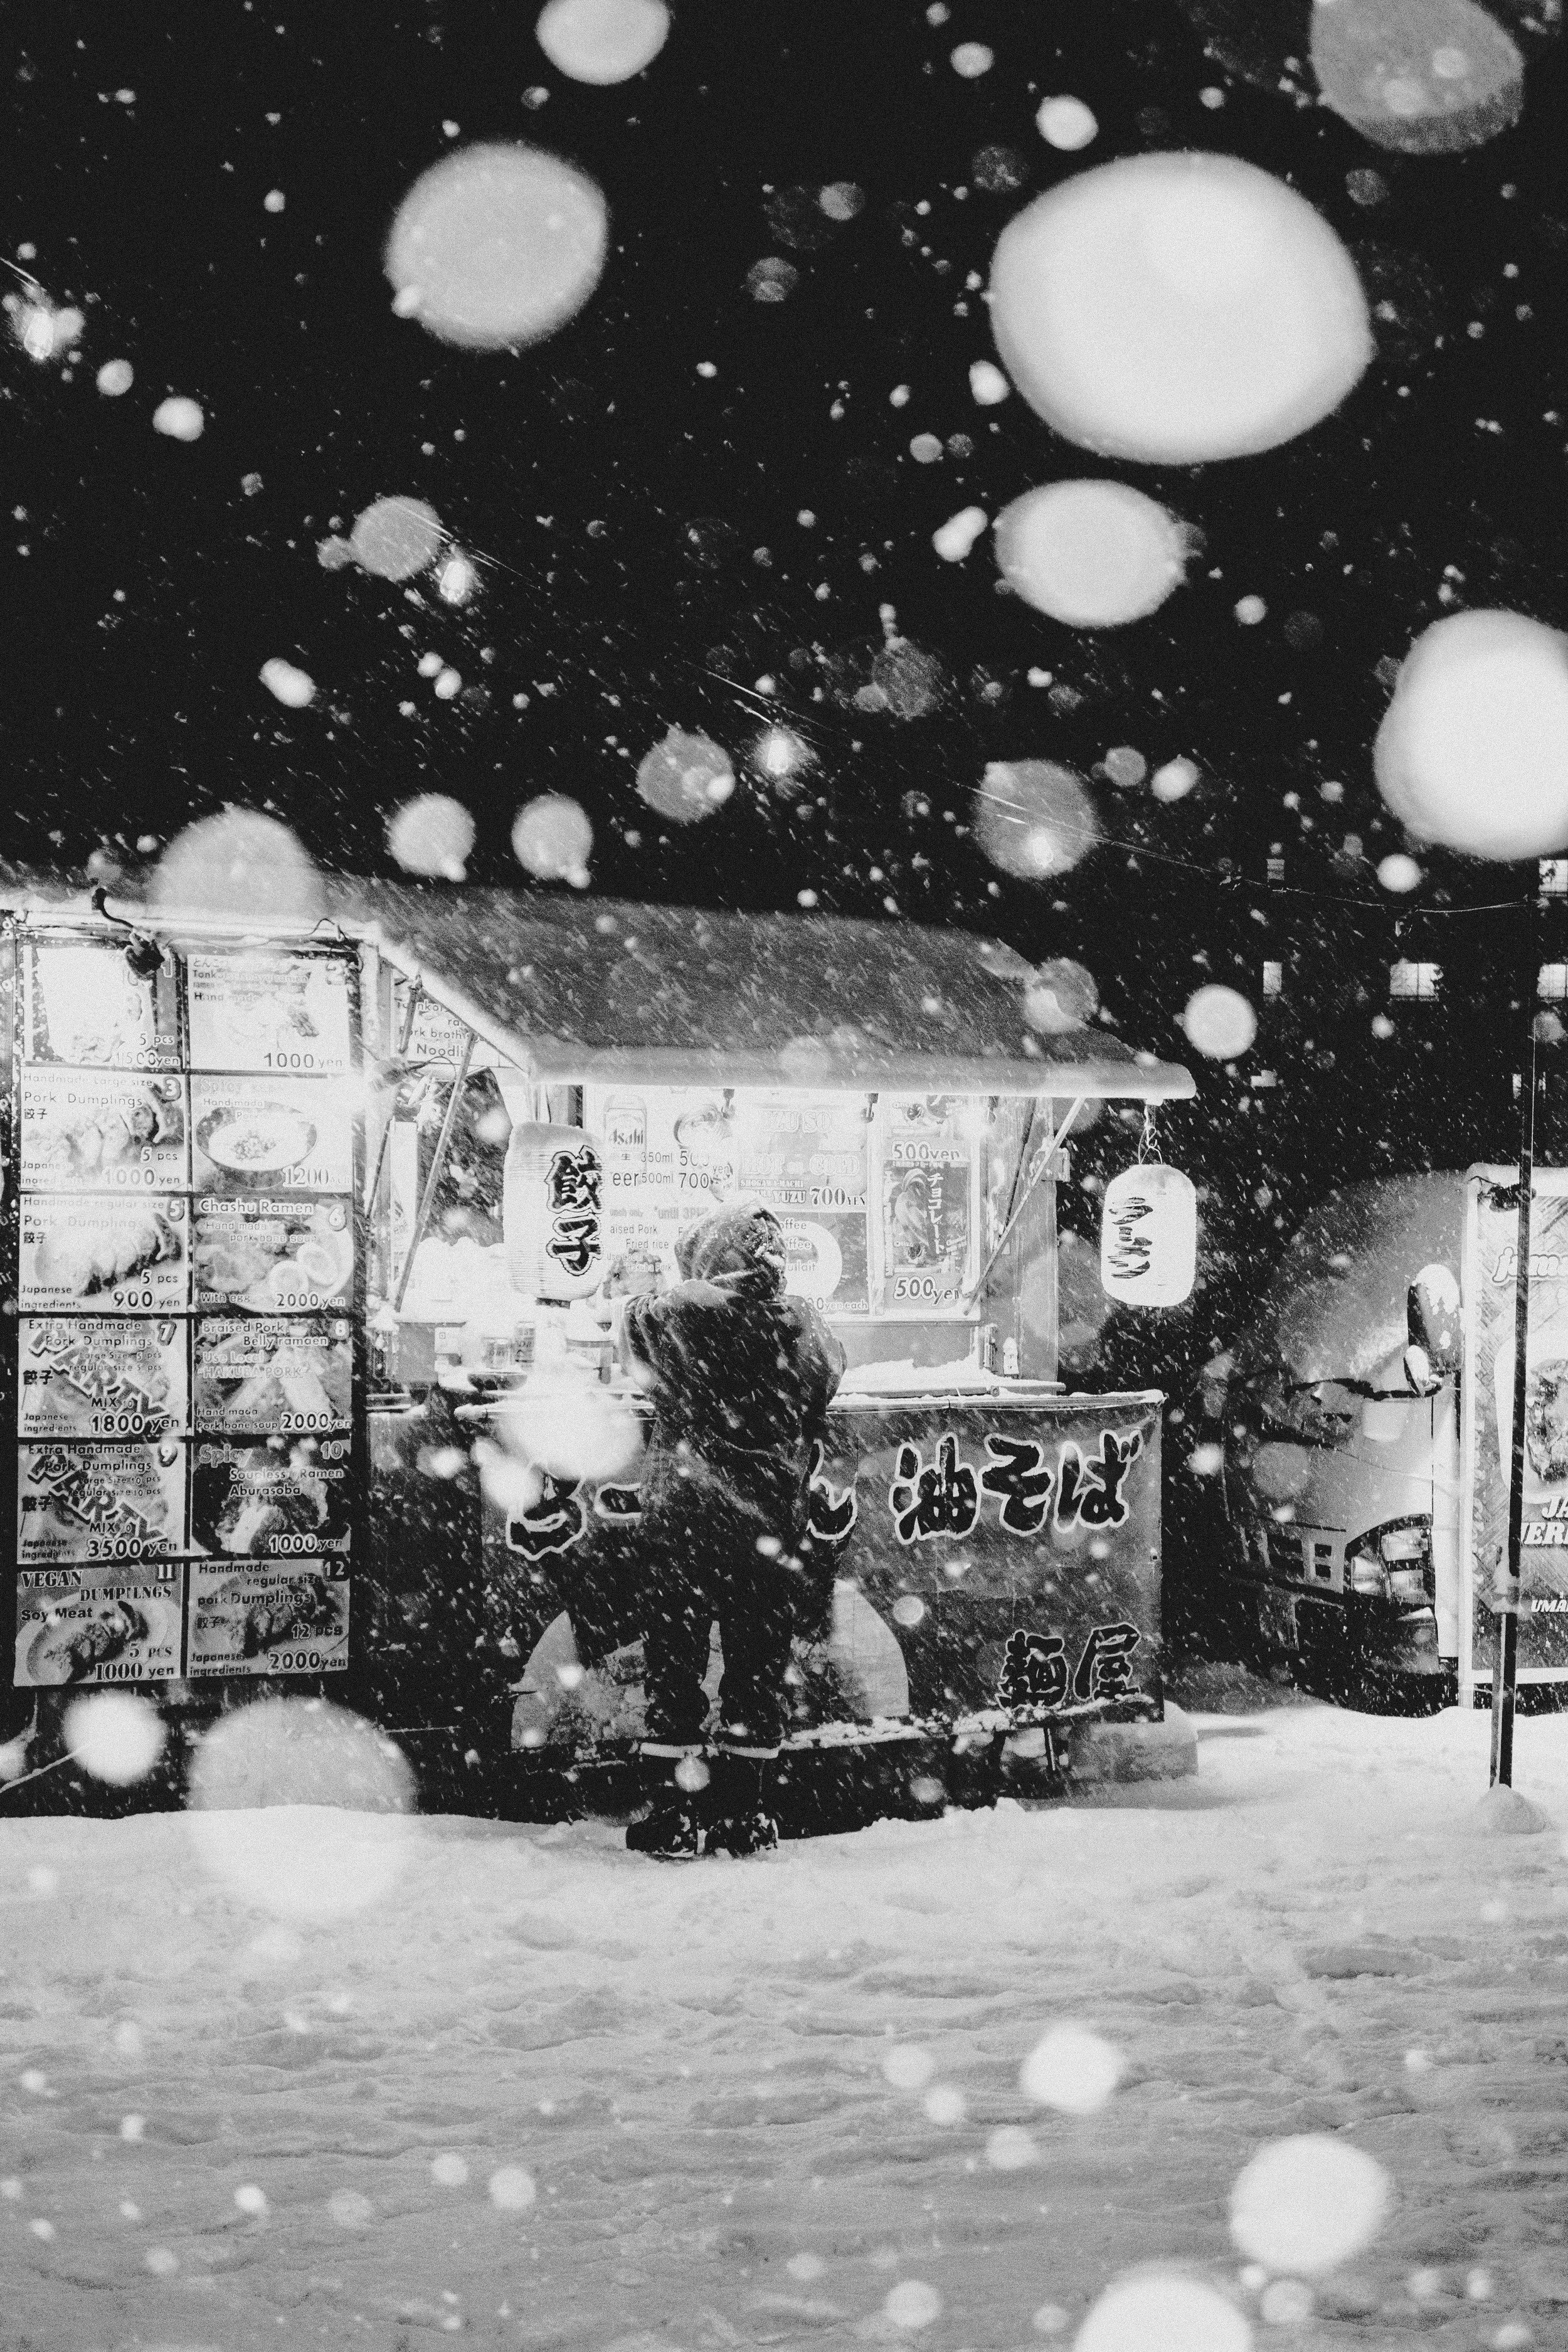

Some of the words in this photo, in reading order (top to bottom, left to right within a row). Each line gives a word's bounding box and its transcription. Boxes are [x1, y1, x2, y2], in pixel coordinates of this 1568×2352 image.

[139, 1033, 147, 1046] 5
[154, 1036, 174, 1046] pcs
[430, 1027, 462, 1039] broth
[263, 1052, 314, 1068] 1000
[318, 1057, 342, 1068] yen
[131, 1078, 153, 1086] size
[24, 1091, 56, 1103] Pork
[67, 1093, 143, 1108] Dumplings
[203, 1098, 231, 1106] Hand
[24, 1108, 48, 1120] 餃子
[608, 1128, 644, 1145] Asahi
[142, 1148, 151, 1162] 5
[157, 1152, 178, 1162] pcs
[640, 1152, 674, 1163] 350ml
[104, 1168, 156, 1185] 1000
[159, 1177, 181, 1186] yen
[612, 1172, 639, 1187] eer
[641, 1172, 674, 1184] 500ml
[678, 1172, 710, 1189] 700
[23, 1197, 90, 1207] Handmade
[94, 1199, 138, 1210] regular
[142, 1200, 165, 1209] size
[200, 1198, 257, 1213] Chashu
[260, 1199, 314, 1215] Ramen
[544, 1144, 603, 1277] 餃子
[927, 1172, 944, 1254] チョコレート
[23, 1214, 58, 1227] Pork
[67, 1216, 143, 1230] Dumplings
[205, 1222, 235, 1231] Hand
[610, 1224, 635, 1234] aised
[638, 1224, 658, 1234] Pork
[626, 1238, 649, 1249] Fried
[652, 1239, 669, 1249] rice
[142, 1271, 151, 1285] 5
[157, 1274, 179, 1285] pcs
[21, 1286, 73, 1295] Japanese
[21, 1298, 82, 1310] ingredients
[112, 1290, 154, 1308] 900
[159, 1298, 181, 1310] yen
[275, 1293, 320, 1308] 2000
[321, 1296, 346, 1309] yen
[845, 1298, 869, 1310] each
[28, 1320, 63, 1330] Extra
[68, 1320, 142, 1330] Handmade
[203, 1322, 251, 1333] Braised
[255, 1322, 285, 1333] Pork
[45, 1335, 77, 1346] Pork
[83, 1335, 152, 1353] Dumplings
[243, 1335, 275, 1349] Belly
[147, 1352, 162, 1360] pcs
[113, 1363, 132, 1371] size
[147, 1363, 162, 1372] pcs
[91, 1397, 117, 1407] MIX
[24, 1413, 68, 1422] Japanese
[196, 1407, 225, 1416] Hand
[24, 1424, 77, 1434] ingredients
[91, 1414, 143, 1433] 1800
[150, 1418, 179, 1433] yen
[196, 1421, 220, 1431] Pork
[253, 1421, 278, 1431] soup
[28, 1444, 63, 1454] Extra
[67, 1444, 141, 1455] Handmade
[199, 1443, 253, 1468] Spicy
[320, 1441, 344, 1460] 10
[44, 1461, 76, 1471] Pork
[82, 1459, 152, 1473] Dumplings
[146, 1475, 161, 1484] pcs
[299, 1468, 345, 1480] Ramen
[146, 1488, 161, 1496] pcs
[229, 1482, 302, 1496] Aburasoba
[888, 1432, 1143, 1545] 油そば
[90, 1522, 116, 1532] MIX
[87, 1539, 142, 1559] 3500
[149, 1542, 177, 1557] yen
[268, 1534, 318, 1553] 1000
[199, 1561, 270, 1574] Handmade
[324, 1560, 346, 1577] 12
[21, 1569, 84, 1589] VEGAN
[246, 1574, 294, 1588] regular
[230, 1589, 312, 1606] Dumplings
[21, 1609, 48, 1623] Soy
[55, 1607, 93, 1619] Meat
[290, 1623, 312, 1640] 12
[315, 1625, 344, 1638] pcs
[129, 1643, 140, 1658] 5
[191, 1653, 244, 1663] Japanese
[95, 1663, 143, 1681] 1000
[148, 1667, 175, 1678] yen
[189, 1666, 252, 1678] ingredients
